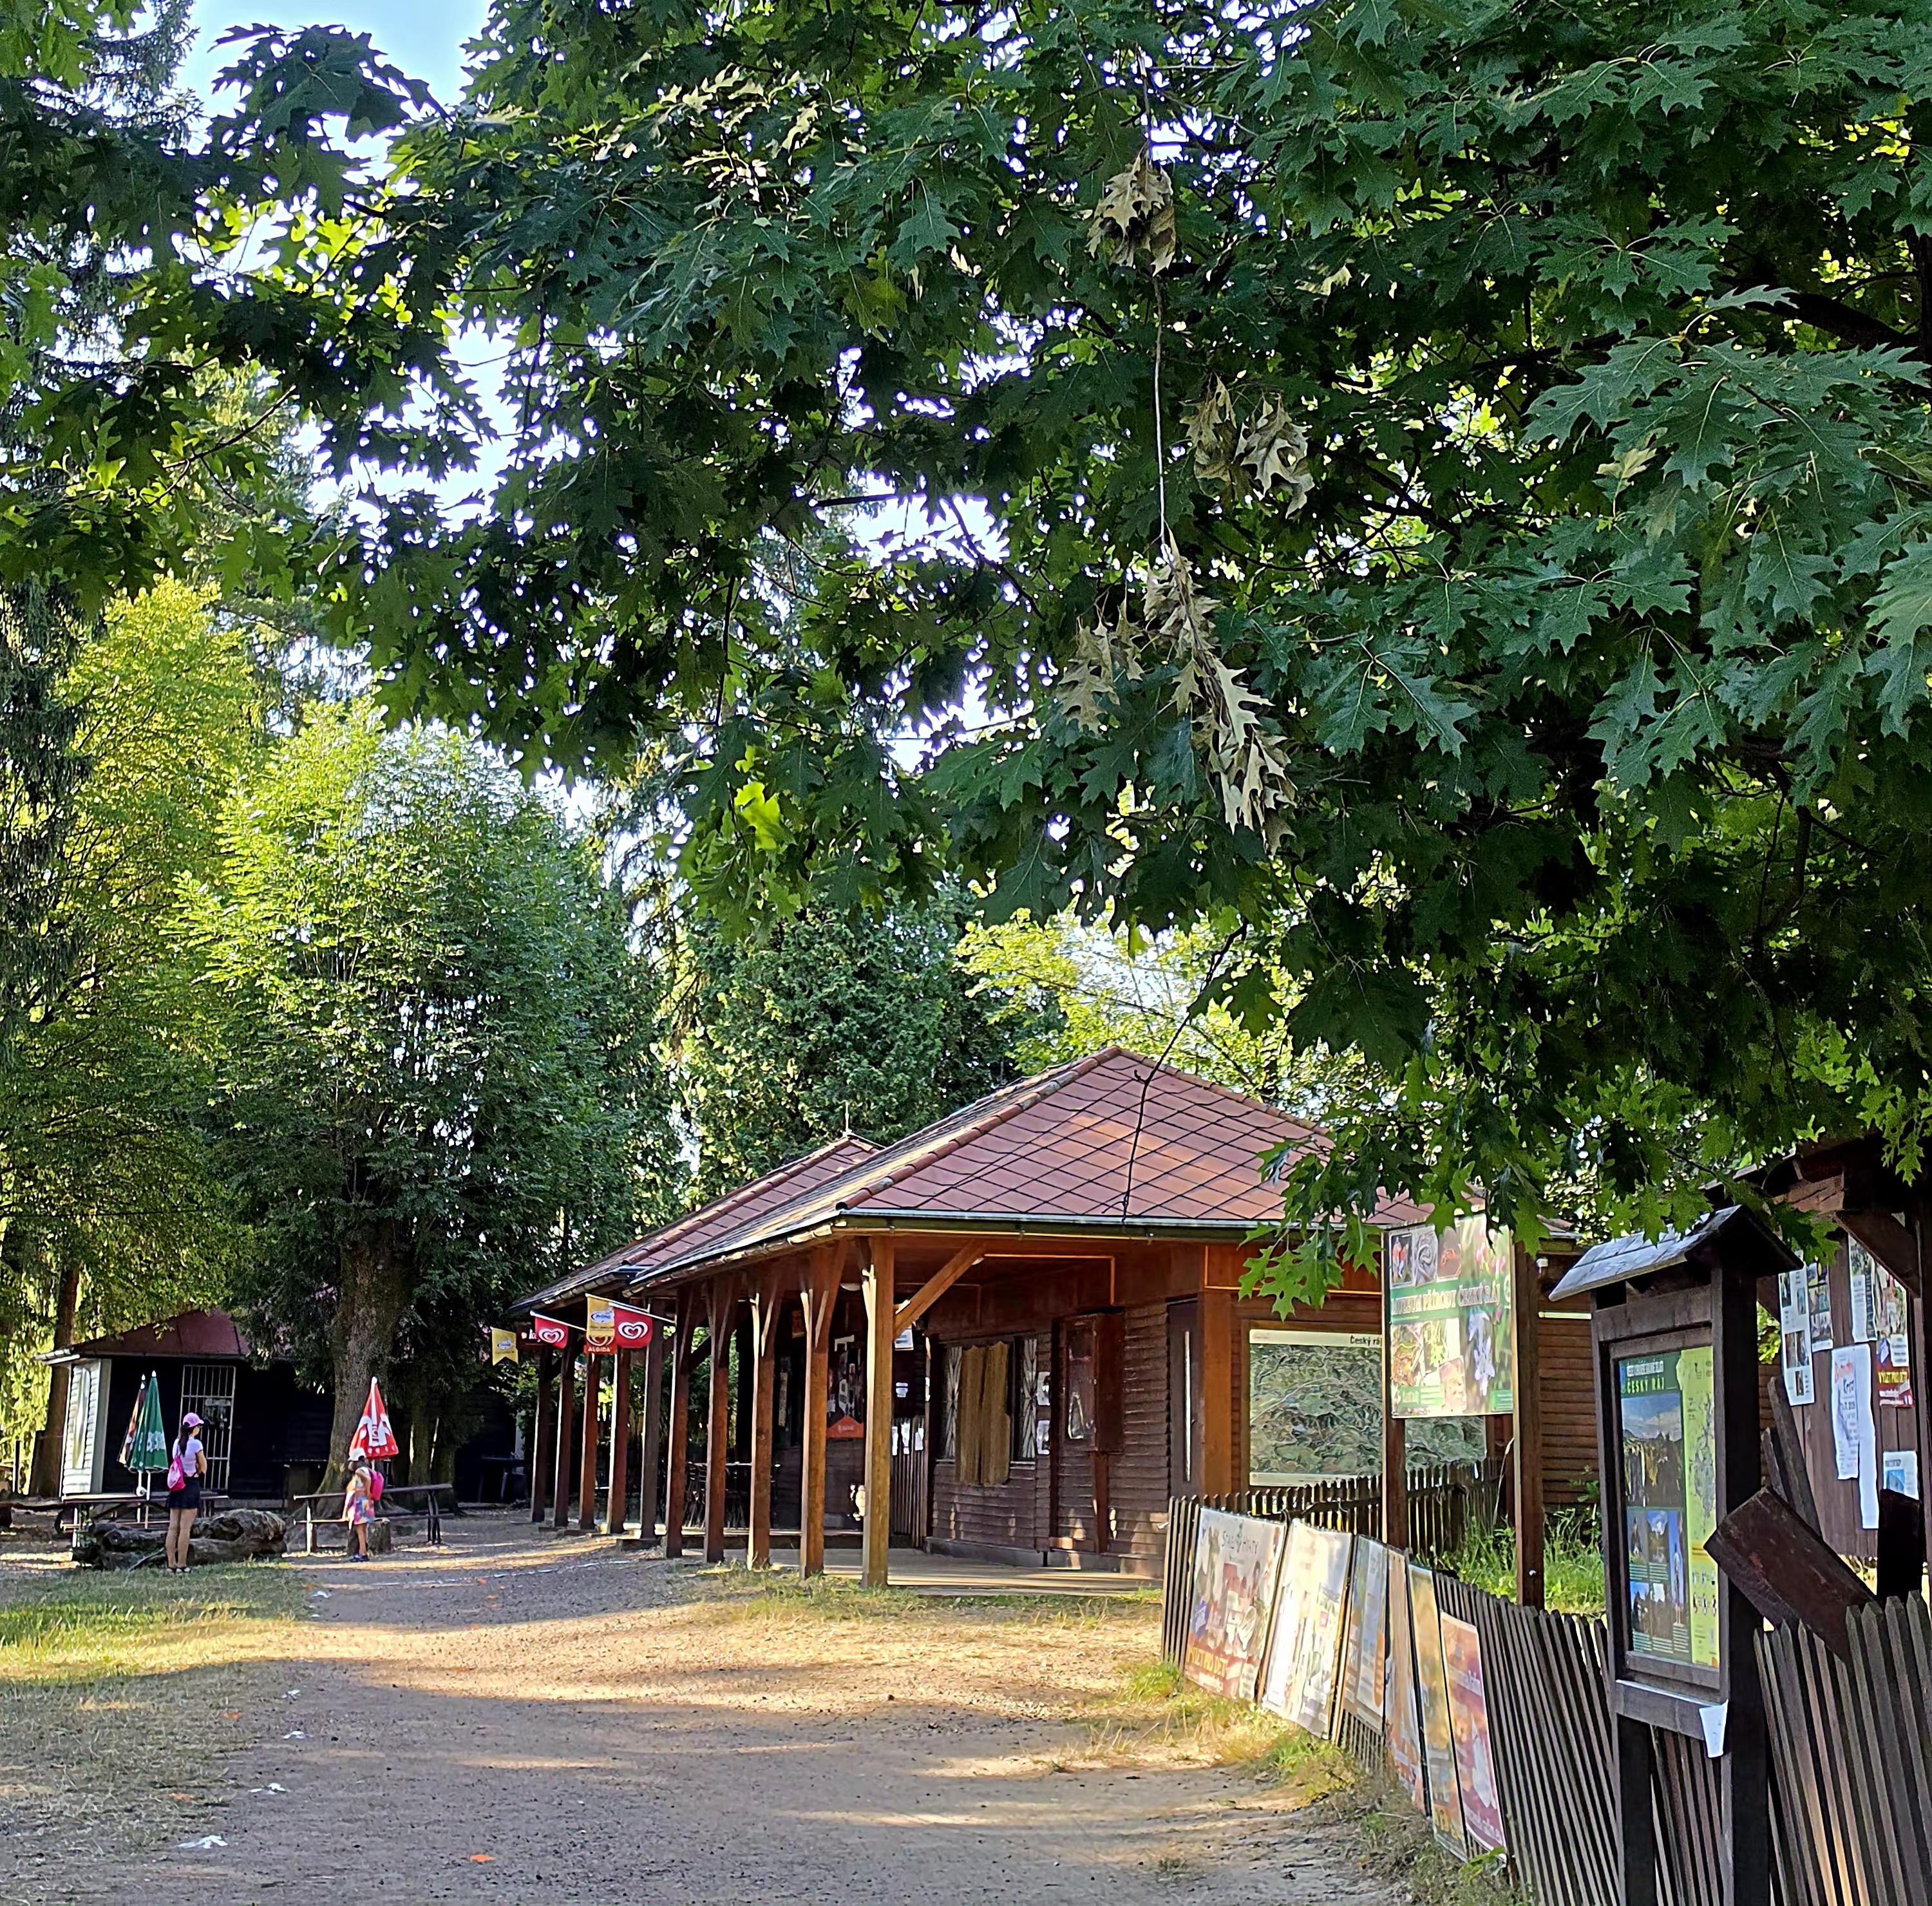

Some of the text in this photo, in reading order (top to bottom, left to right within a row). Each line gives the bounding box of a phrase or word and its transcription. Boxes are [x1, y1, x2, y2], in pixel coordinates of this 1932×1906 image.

[1350, 1335, 1371, 1346] Český
[1627, 1375, 1665, 1393] ČESKÝ RÁJ
